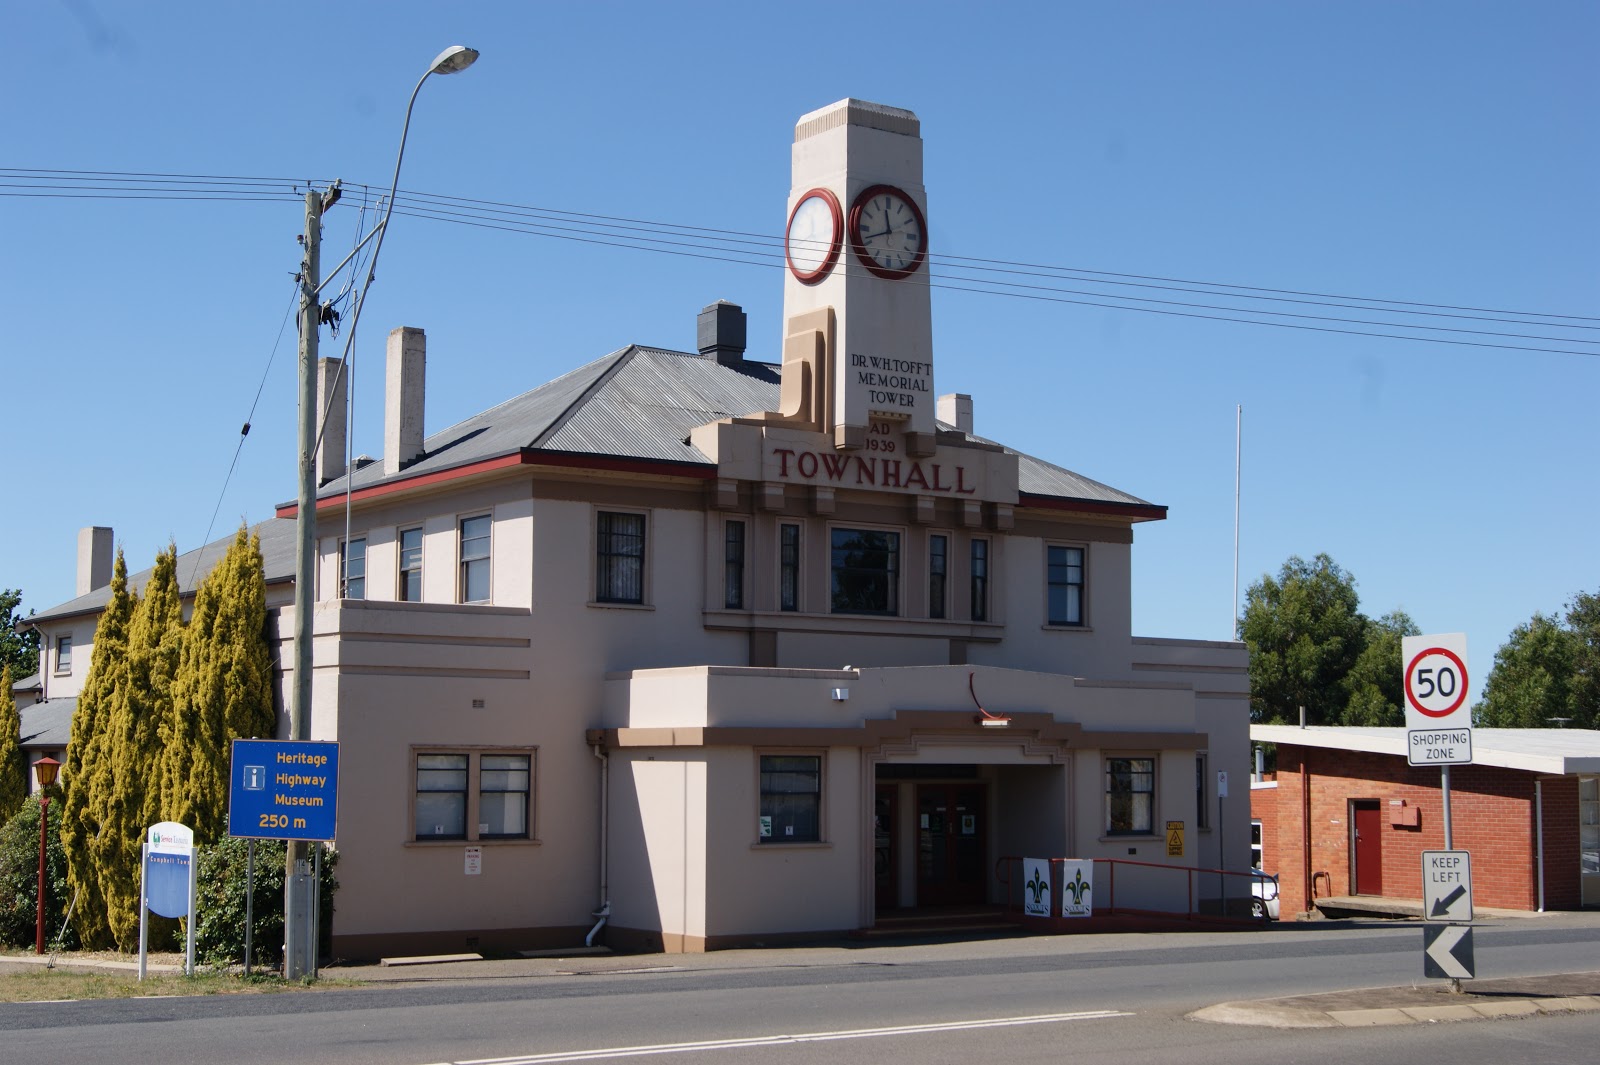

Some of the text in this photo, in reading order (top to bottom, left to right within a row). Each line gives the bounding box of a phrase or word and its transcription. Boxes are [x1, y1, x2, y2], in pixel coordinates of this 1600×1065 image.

[858, 371, 929, 392] MEMORIAL
[869, 389, 914, 407] TOWER
[870, 422, 891, 435] AD
[865, 438, 896, 453] 1939
[773, 448, 976, 495] TOWNHALL
[1418, 667, 1455, 699] 50
[1412, 732, 1467, 746] SHOPPING
[276, 752, 328, 768] Heritage
[1426, 748, 1455, 760] ZONE
[275, 773, 327, 789] Highway
[275, 793, 324, 807] Museum
[259, 814, 307, 829] 250 m
[150, 855, 175, 865] Campbell
[1432, 857, 1460, 868] KEEP
[1432, 872, 1461, 882] LEFT
